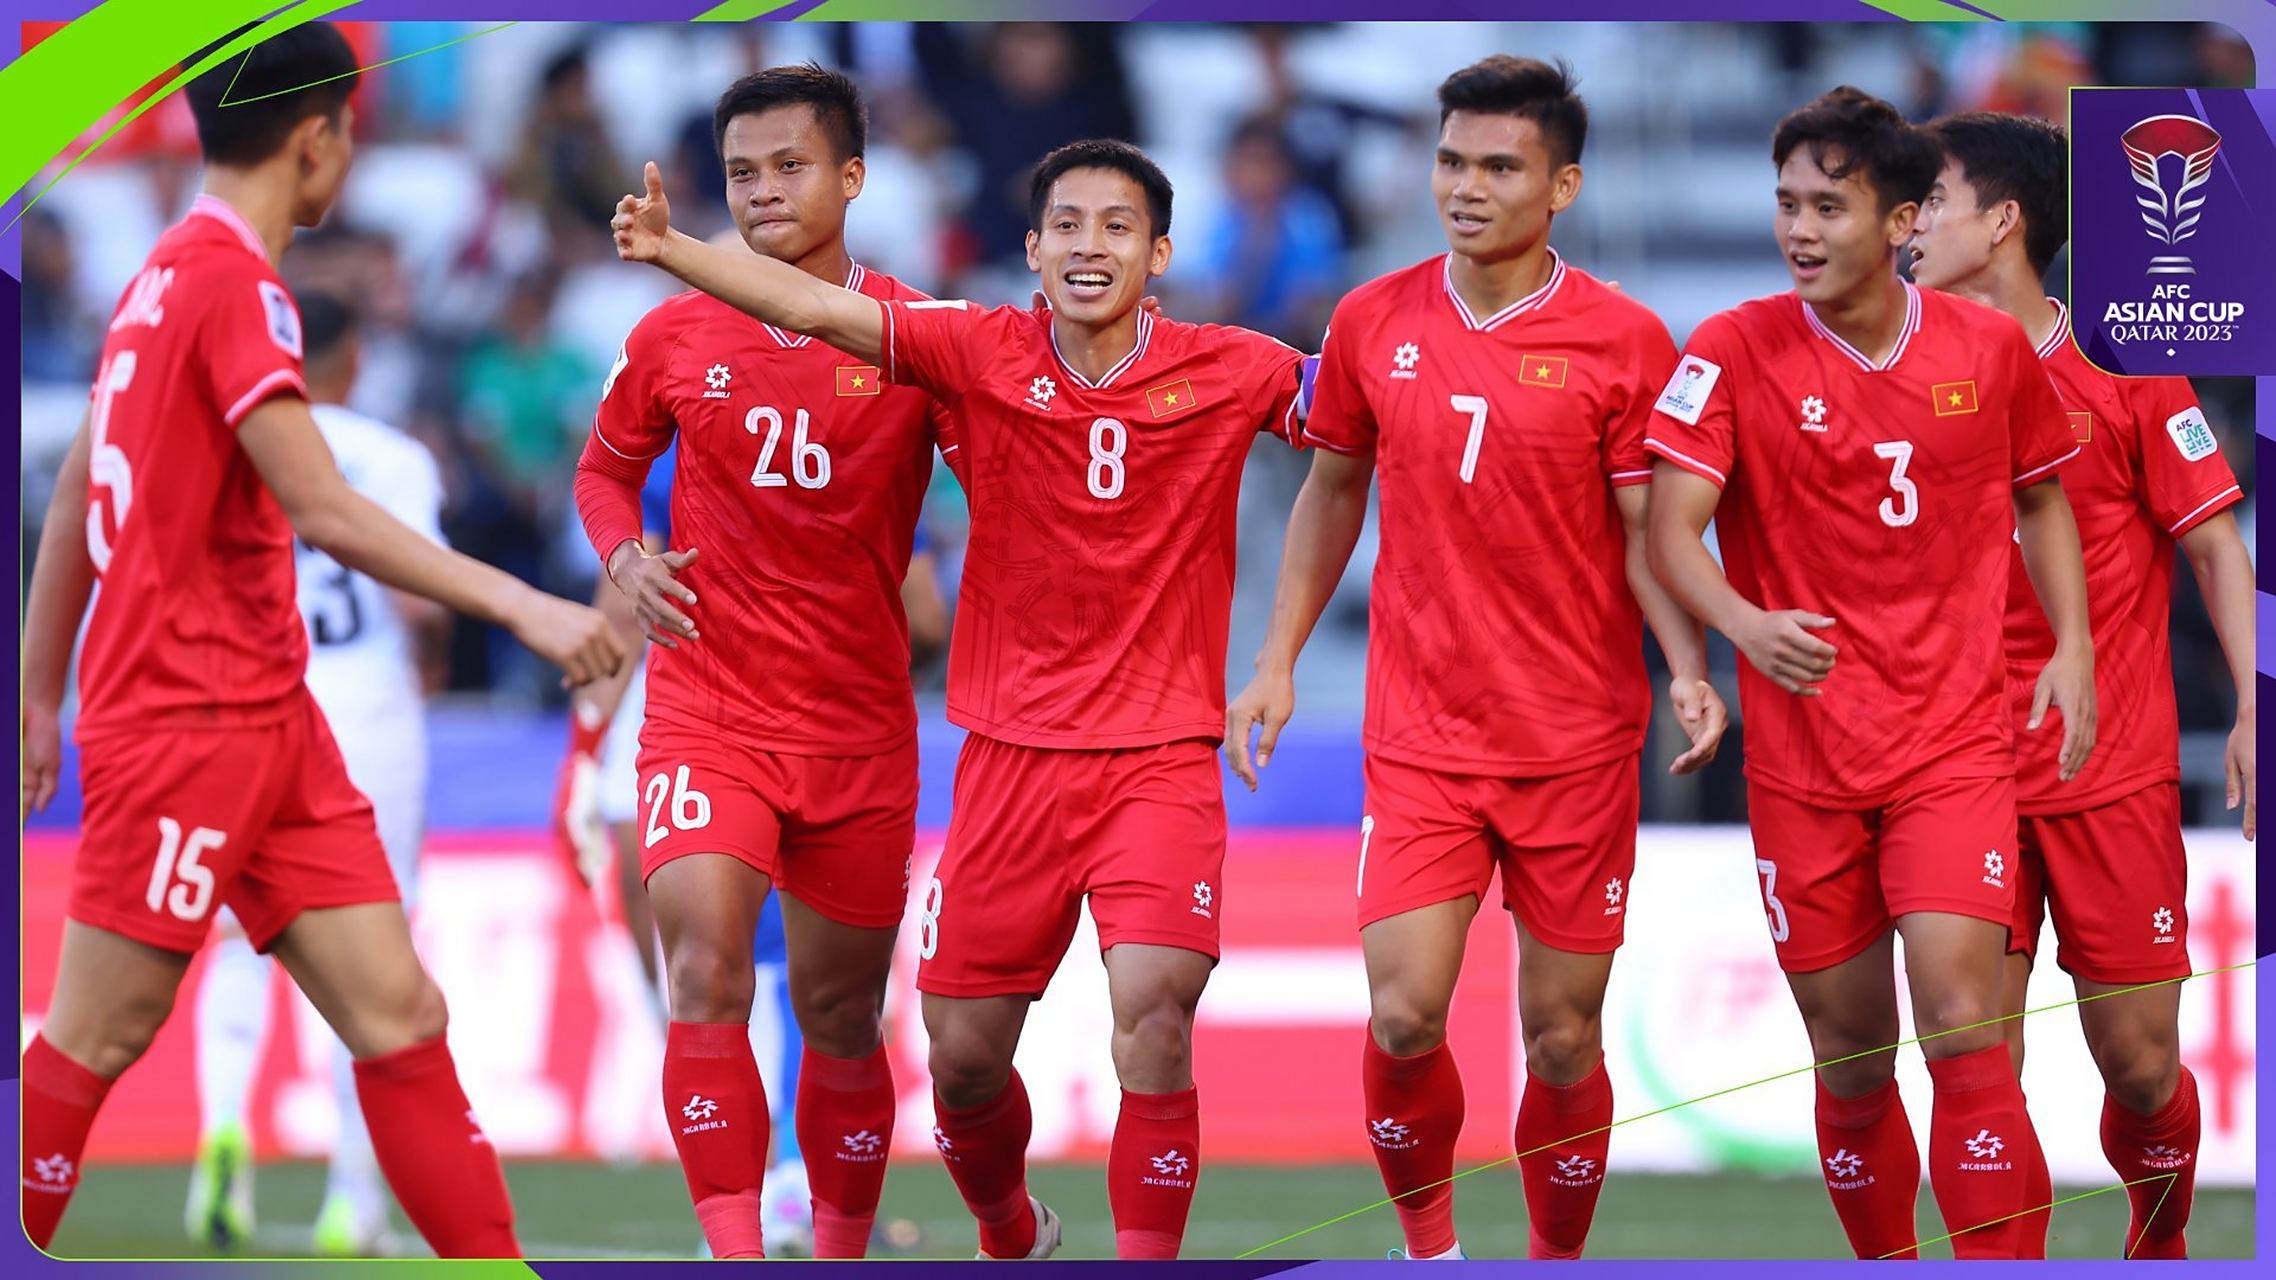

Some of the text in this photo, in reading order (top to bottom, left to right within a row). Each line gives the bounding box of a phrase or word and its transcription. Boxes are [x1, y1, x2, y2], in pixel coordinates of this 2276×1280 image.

[744, 406, 832, 490] 26
[1087, 417, 1128, 500] 8
[1450, 394, 1489, 484] 7
[2176, 419, 2193, 432] AFC
[2179, 423, 2209, 443] LIVE
[1873, 440, 1919, 527] 3
[644, 764, 712, 849] 26
[146, 815, 228, 923] 15
[1757, 858, 1790, 943] 3
[921, 876, 943, 960] 8
